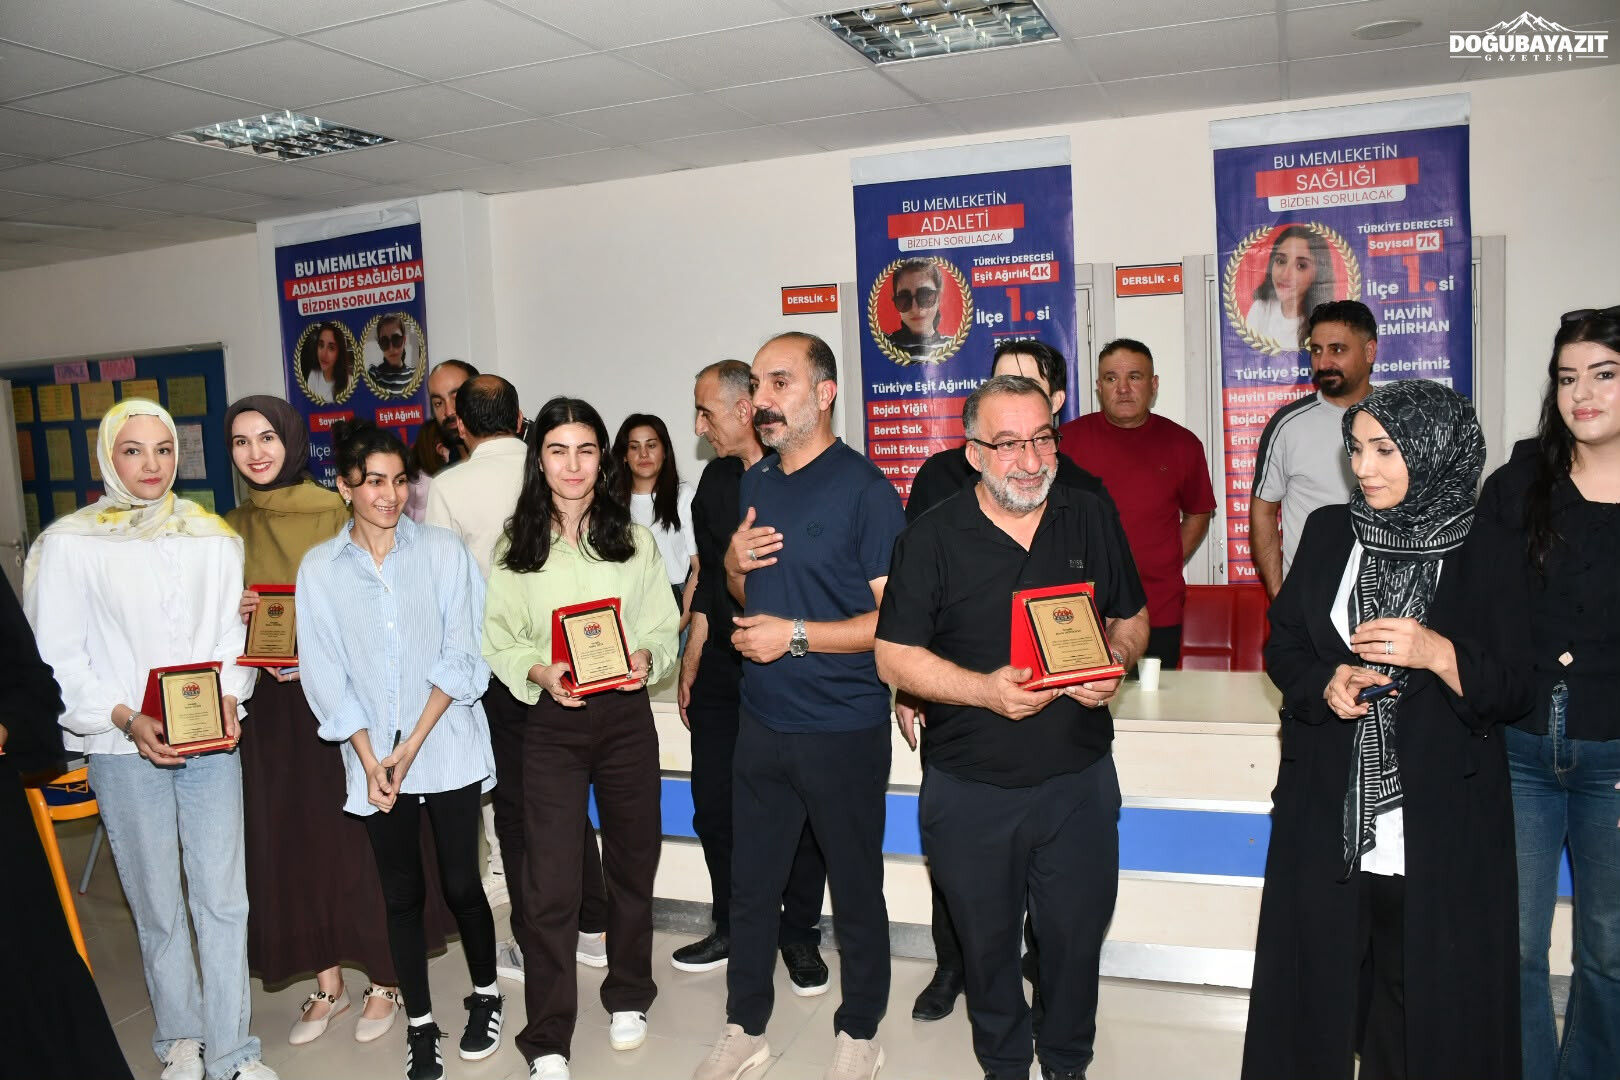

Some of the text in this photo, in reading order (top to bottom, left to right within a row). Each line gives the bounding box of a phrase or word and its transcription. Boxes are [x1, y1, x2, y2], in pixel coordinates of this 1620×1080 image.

[1274, 143, 1398, 170] BU MEMLEKETİN
[1296, 166, 1376, 191] SAĞLIĞI
[902, 191, 1006, 213] BU MEMLEKETİN
[1280, 190, 1393, 208] BİZDEN SORULACAK
[920, 210, 989, 232] ADALETİ
[1357, 216, 1453, 234] TÜRKİYE DERECESİ
[907, 232, 1003, 248] BİZDEN SORULACAK
[1369, 236, 1438, 251] Sayısal 7K
[294, 243, 413, 278] BU MEMLEKETİN
[973, 251, 1054, 266] TÜRKİYE DERECESİ
[292, 265, 422, 297] ADALETİ DE SAĞLIĞI DA
[974, 265, 1050, 284] Eşit Ağırlık 4K
[1122, 274, 1165, 286] DERSLİK
[1173, 274, 1180, 282] 6
[787, 294, 824, 304] DERSLİK
[1367, 280, 1399, 301] İlçe
[302, 287, 412, 314] BİZDEN SORULACAK
[976, 308, 1004, 327] İlçe
[1384, 304, 1432, 321] HAVİN
[1377, 320, 1450, 336] EMİRHAN
[1235, 366, 1288, 382] Türkiye
[1372, 357, 1450, 372] ecelerimiz
[872, 382, 912, 395] Türkiye
[915, 381, 935, 394] Eşit
[938, 379, 978, 393] Ağırlık
[1228, 392, 1264, 403] Havin
[379, 410, 420, 423] Eşit Ağırlık
[873, 403, 928, 418] Rojda Yiğit
[1230, 414, 1265, 426] Rojda
[874, 424, 922, 435] Berat Sak
[310, 443, 331, 461] İlçe
[874, 444, 929, 456] Ümit Erkuş
[880, 466, 899, 475] mre
